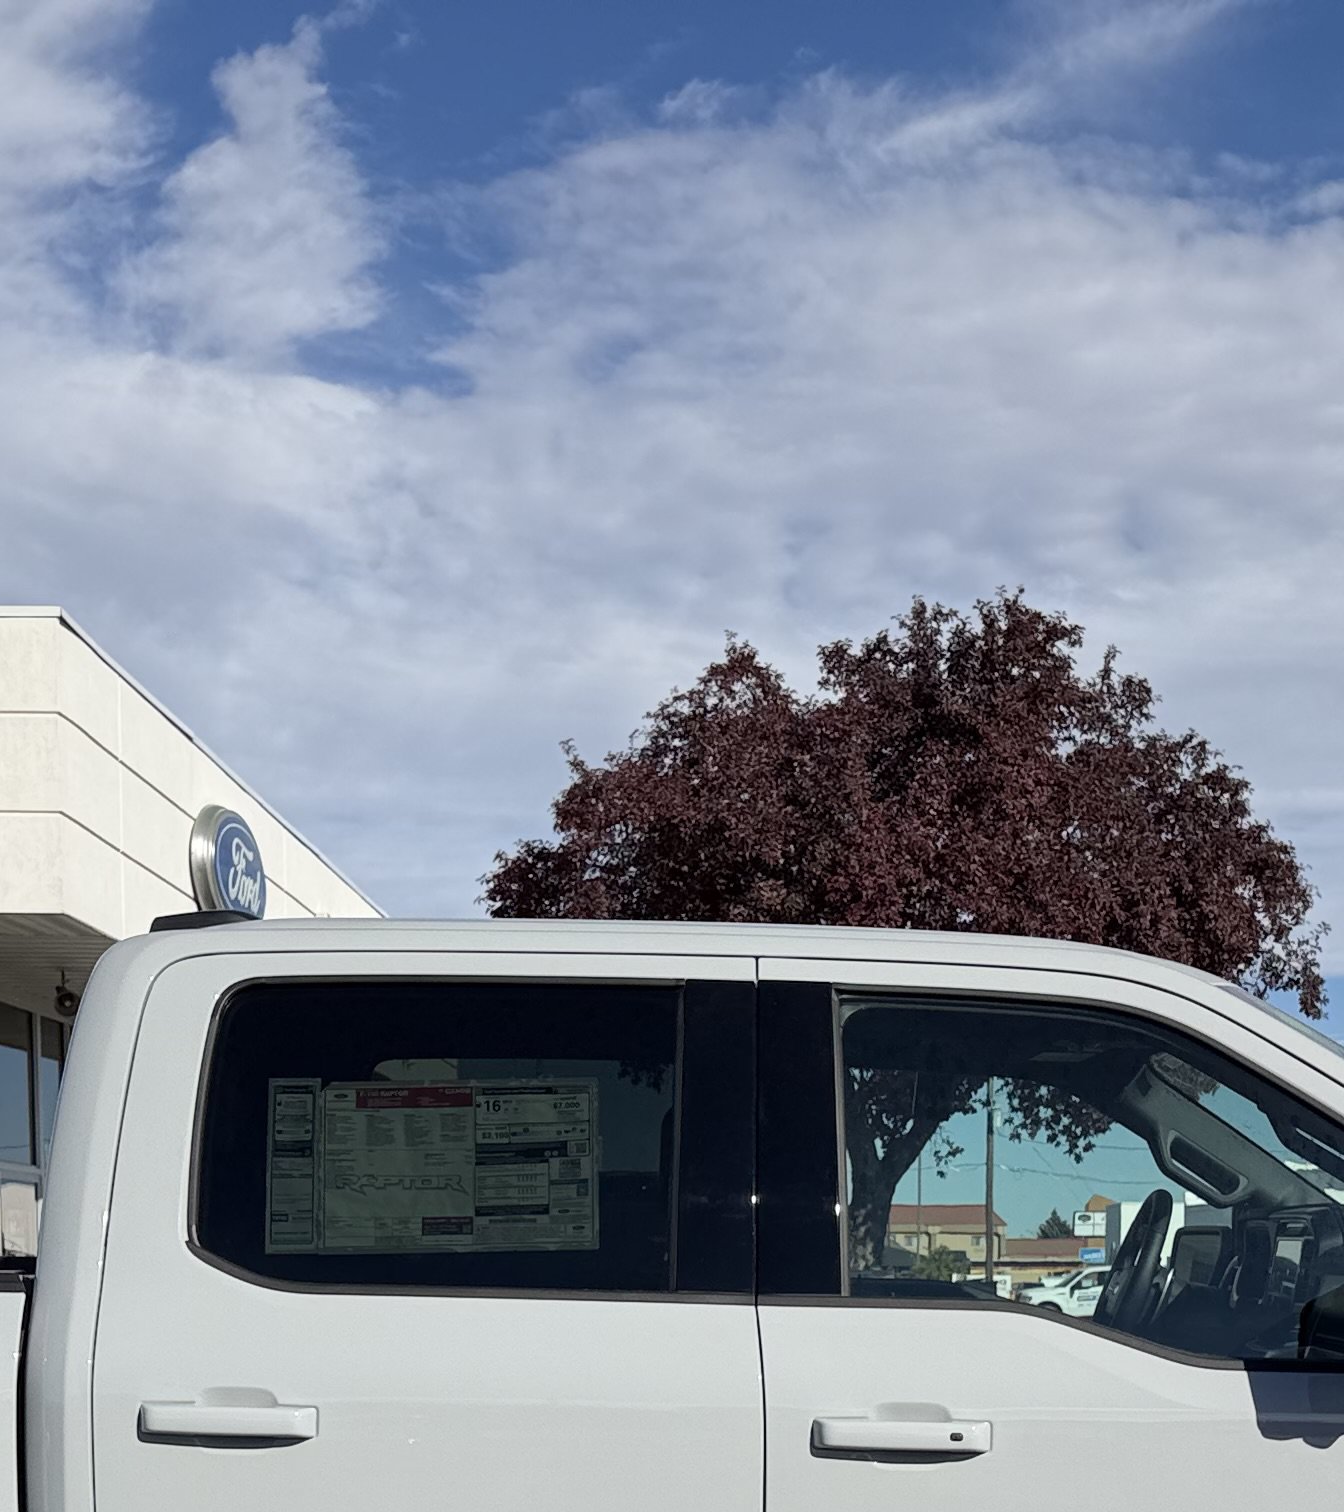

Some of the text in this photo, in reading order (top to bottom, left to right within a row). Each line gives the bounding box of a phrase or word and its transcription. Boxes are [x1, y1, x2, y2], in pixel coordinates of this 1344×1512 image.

[228, 836, 261, 915] Ford
[484, 1100, 501, 1112] 16
[336, 1174, 469, 1196] RAPTOR
